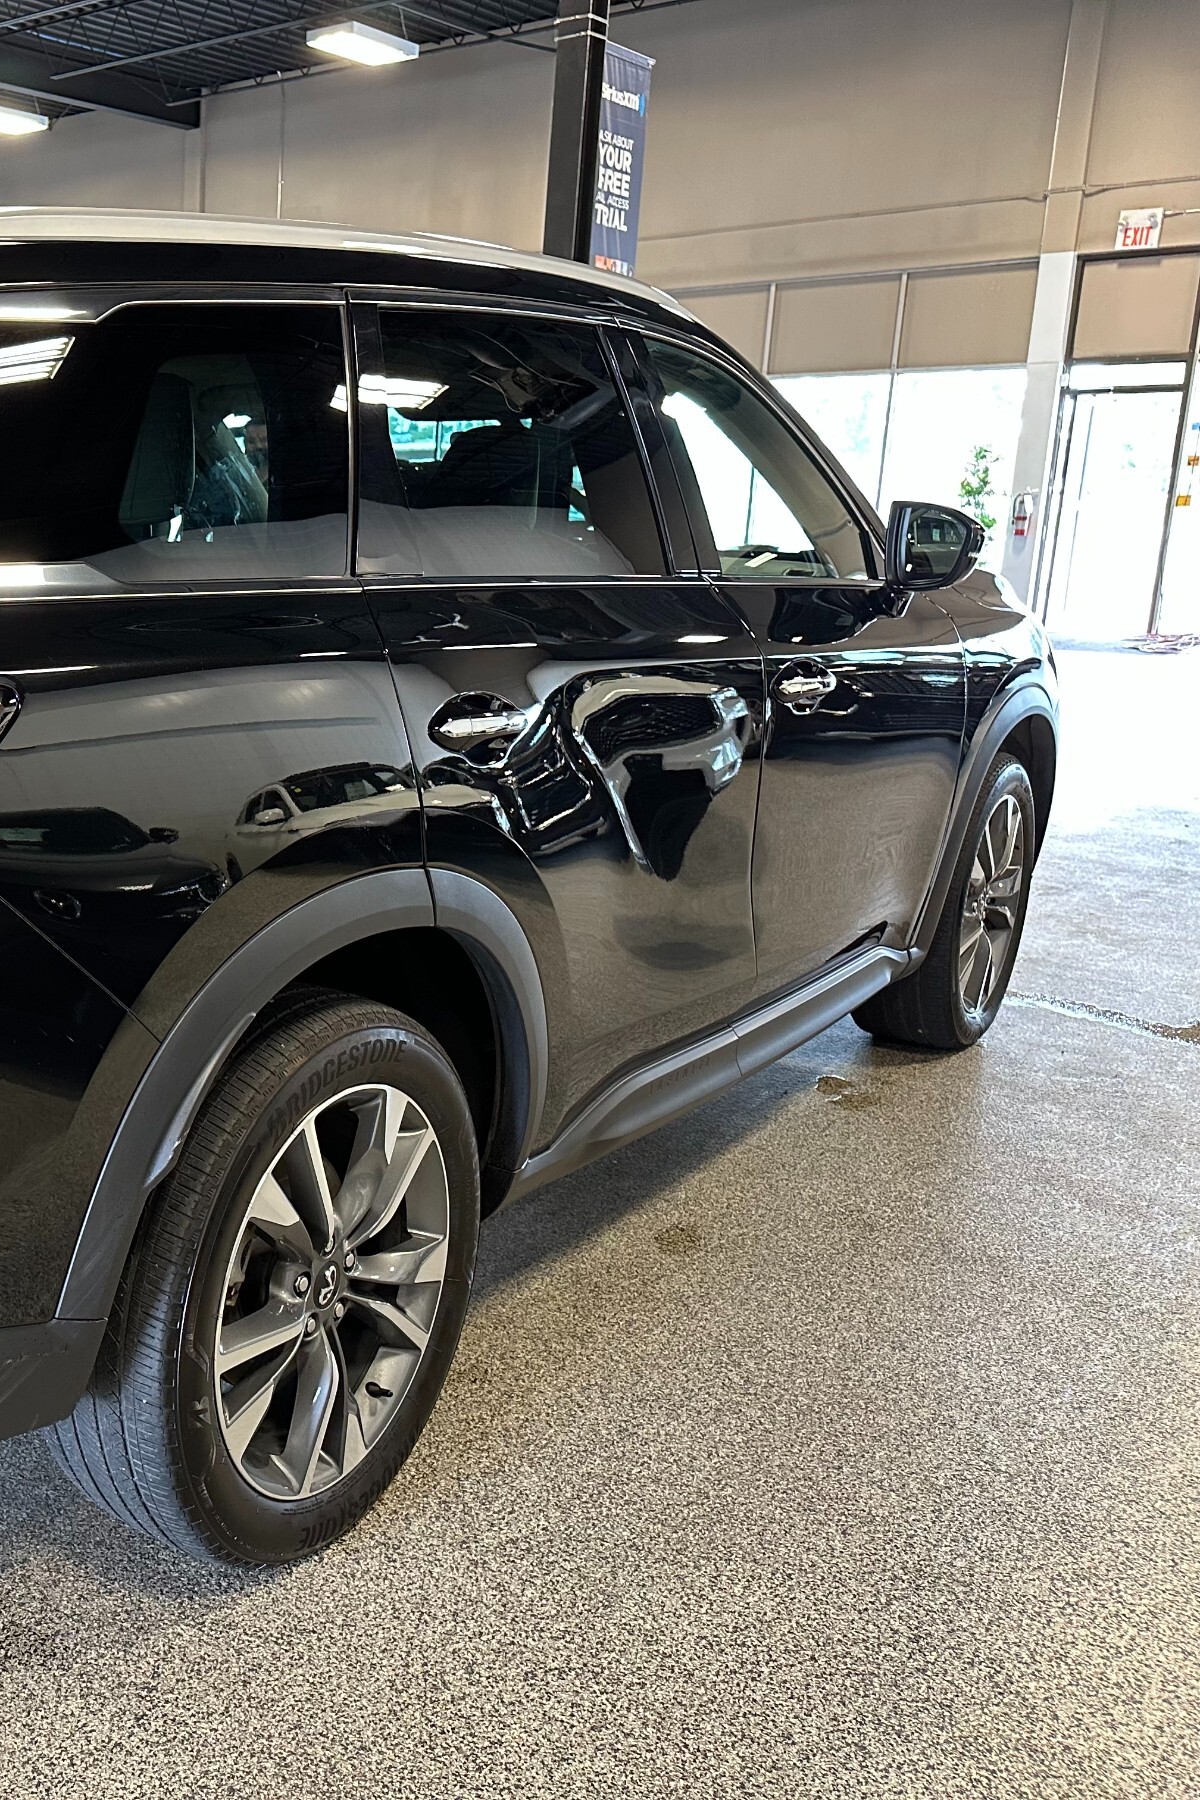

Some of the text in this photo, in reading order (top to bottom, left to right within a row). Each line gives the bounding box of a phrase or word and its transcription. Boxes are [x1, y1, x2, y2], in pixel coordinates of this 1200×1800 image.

[600, 129, 634, 151] ASK ABOUT
[600, 142, 632, 173] YOUR
[598, 165, 630, 198] FREE
[595, 203, 628, 232] TRIAL
[607, 195, 630, 211] ACCESS
[1122, 226, 1153, 247] EXIT
[266, 1038, 407, 1145] BRIDGESTONE
